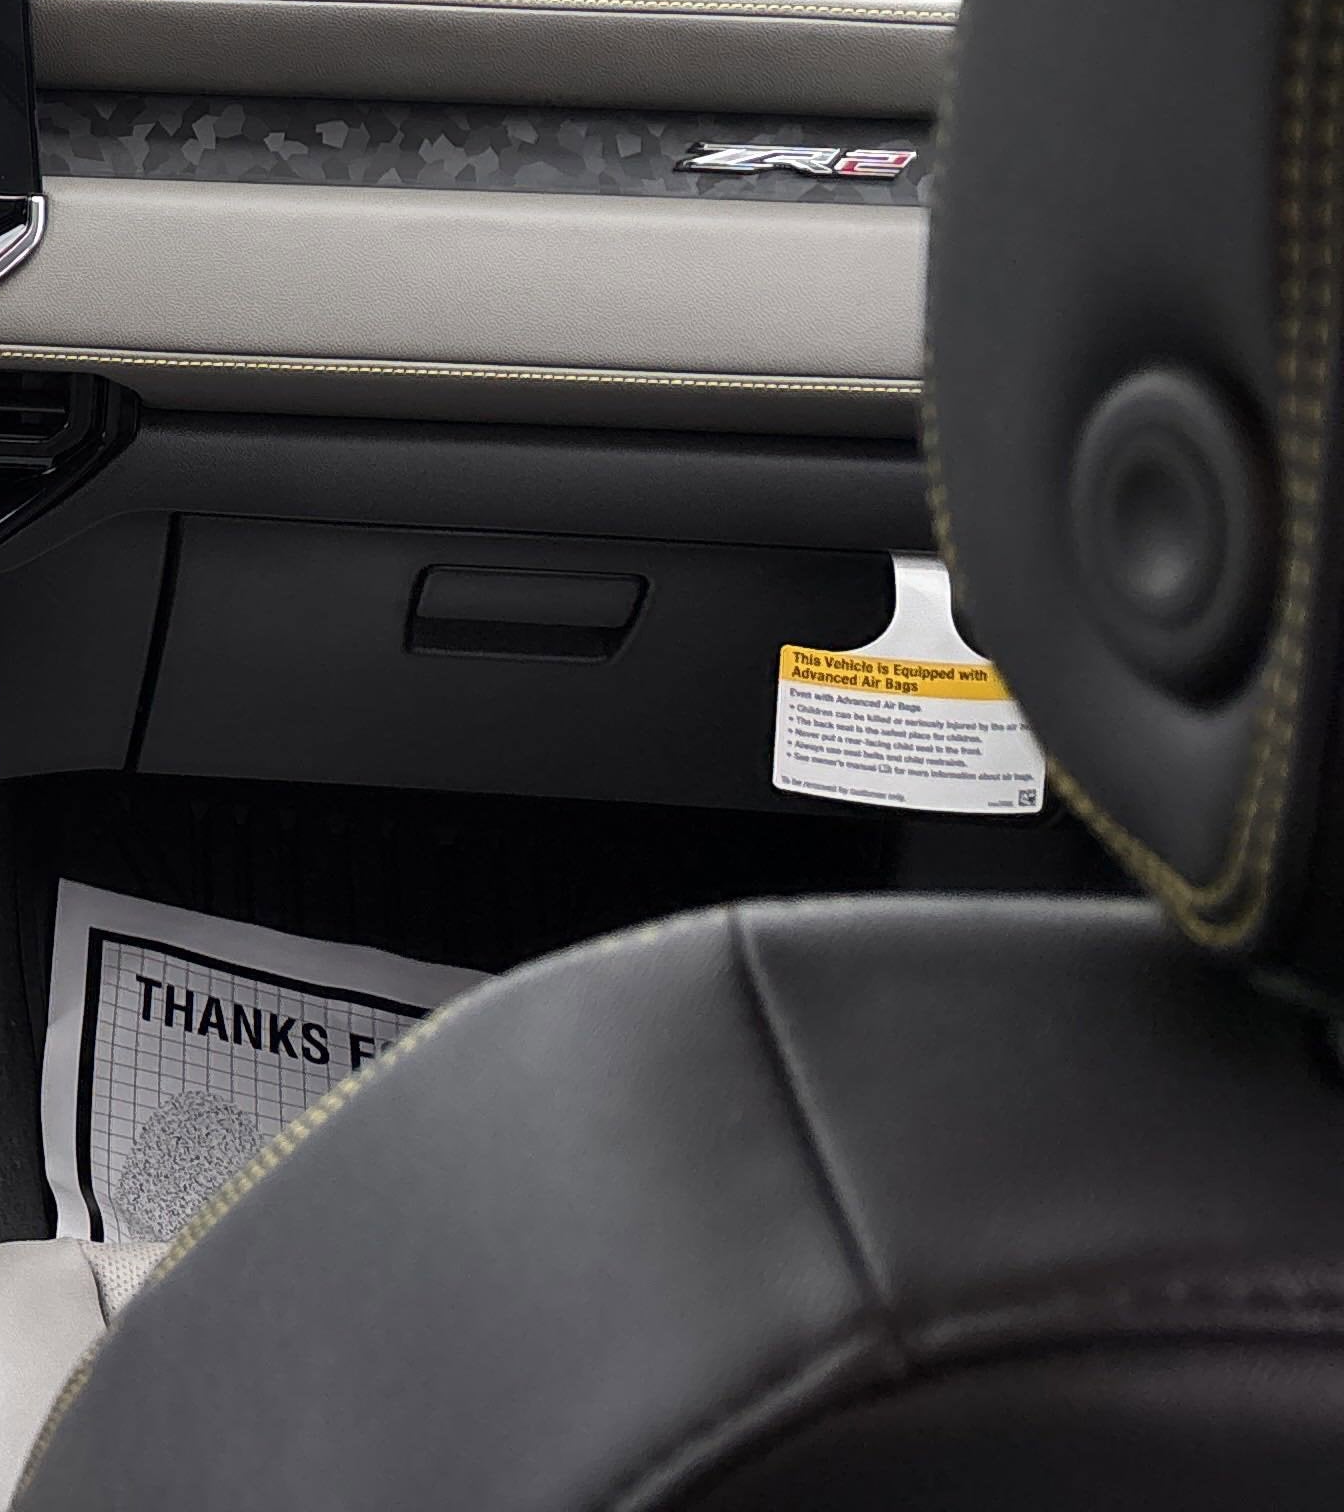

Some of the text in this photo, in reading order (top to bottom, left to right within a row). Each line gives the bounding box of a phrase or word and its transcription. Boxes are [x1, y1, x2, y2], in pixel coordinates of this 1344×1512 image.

[791, 666, 919, 693] Advanced Air Bags
[794, 651, 988, 681] This Vehicle is Equipped with
[836, 695, 881, 708] Advanced
[136, 974, 330, 1065] THANKS
